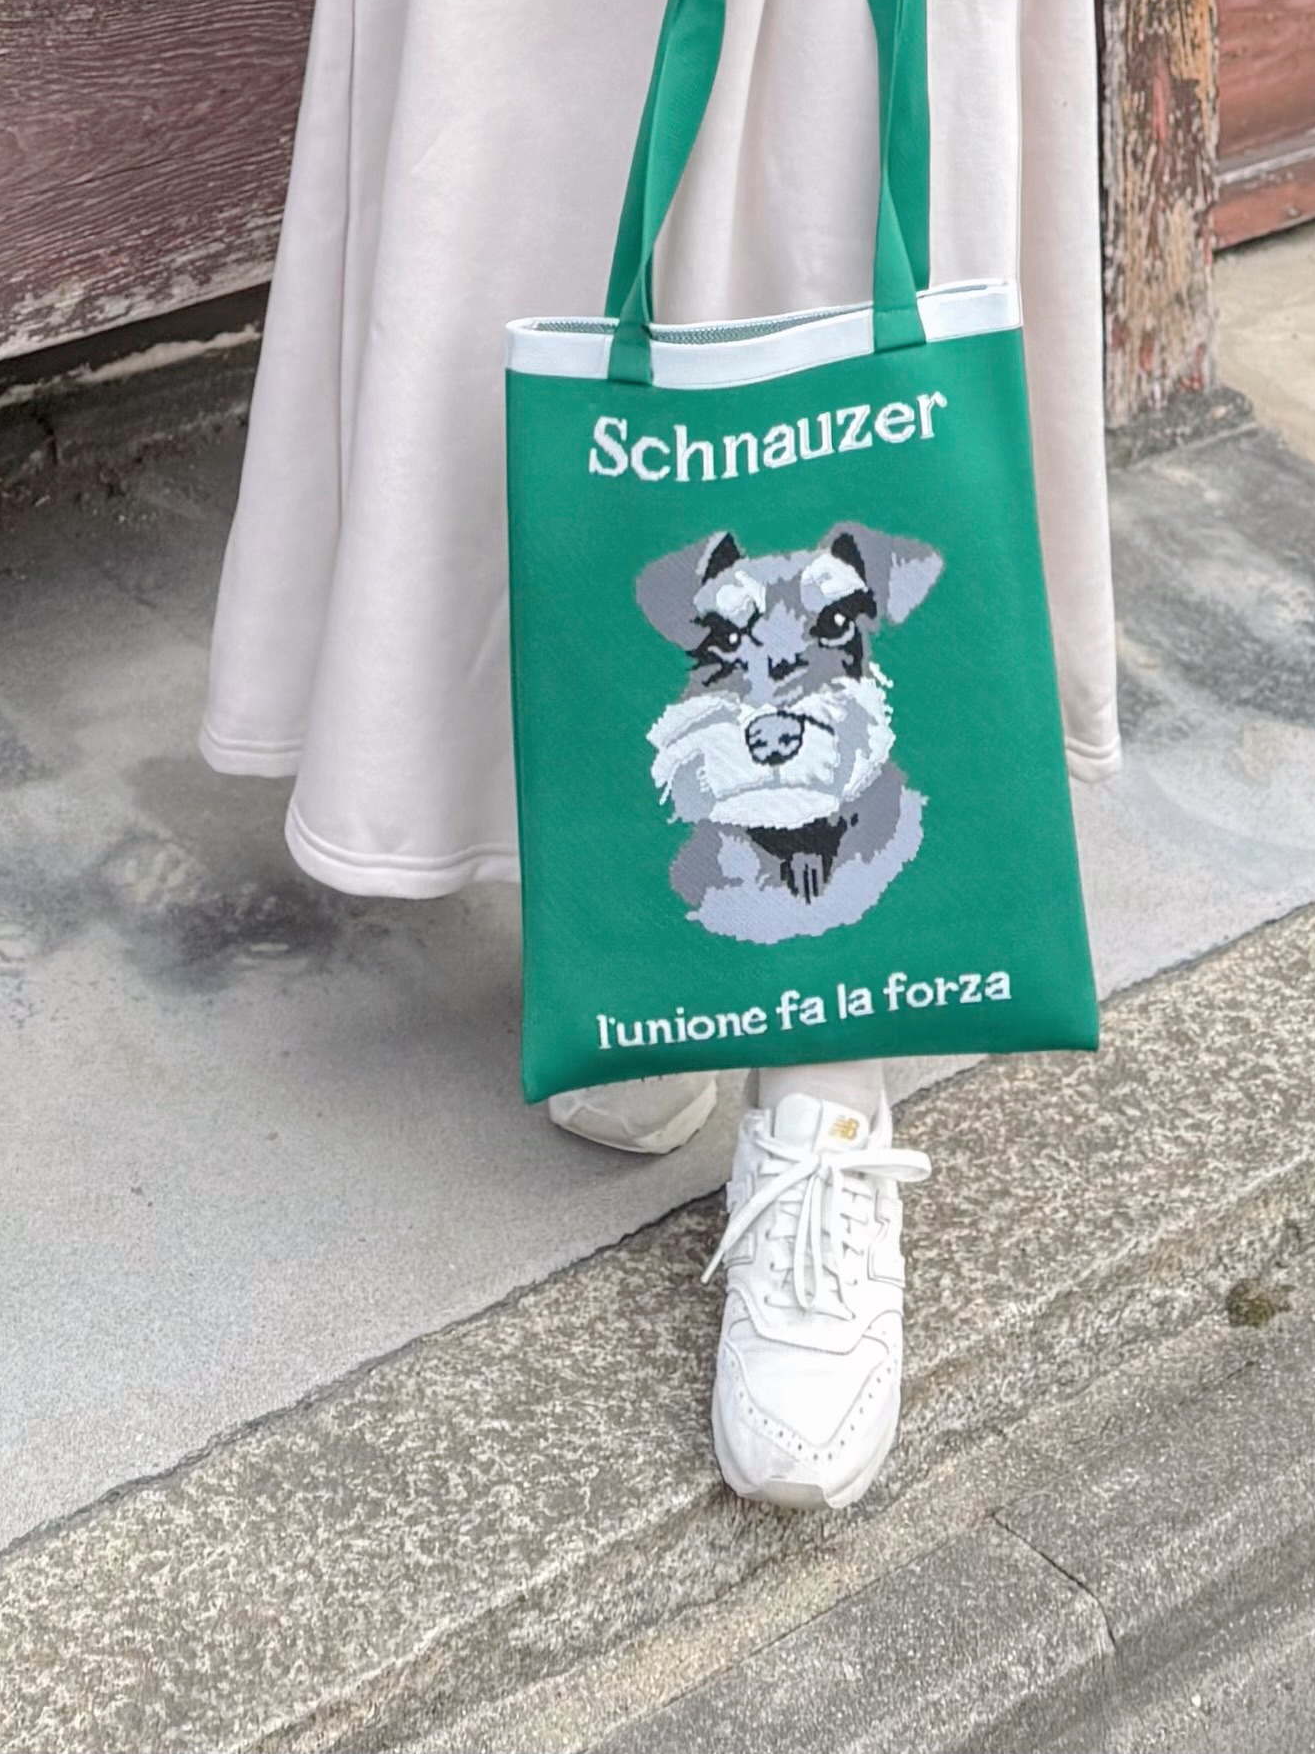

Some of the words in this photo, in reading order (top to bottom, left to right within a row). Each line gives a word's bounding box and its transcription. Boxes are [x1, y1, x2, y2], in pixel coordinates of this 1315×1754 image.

[588, 389, 948, 482] Schnauzer
[596, 1006, 768, 1050] l'unione
[774, 989, 827, 1031] fa
[836, 982, 875, 1020] la
[882, 970, 1013, 1012] forza
